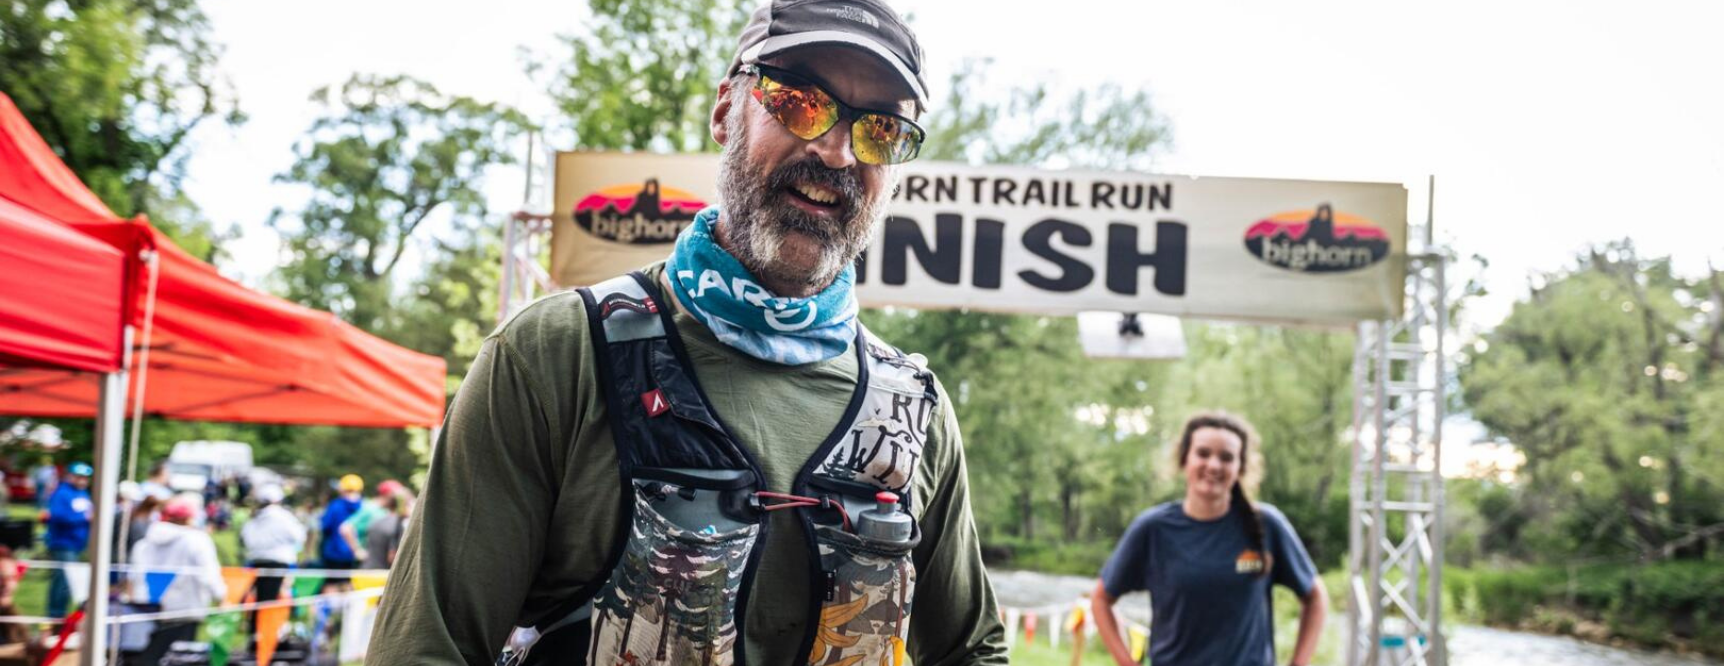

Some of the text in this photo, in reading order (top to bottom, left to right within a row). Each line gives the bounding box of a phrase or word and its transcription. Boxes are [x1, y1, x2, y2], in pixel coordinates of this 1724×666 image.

[968, 177, 1080, 207] TRAIL
[1091, 181, 1172, 211] RUN
[856, 212, 1188, 296] NISH
[1261, 236, 1373, 271] bighorn
